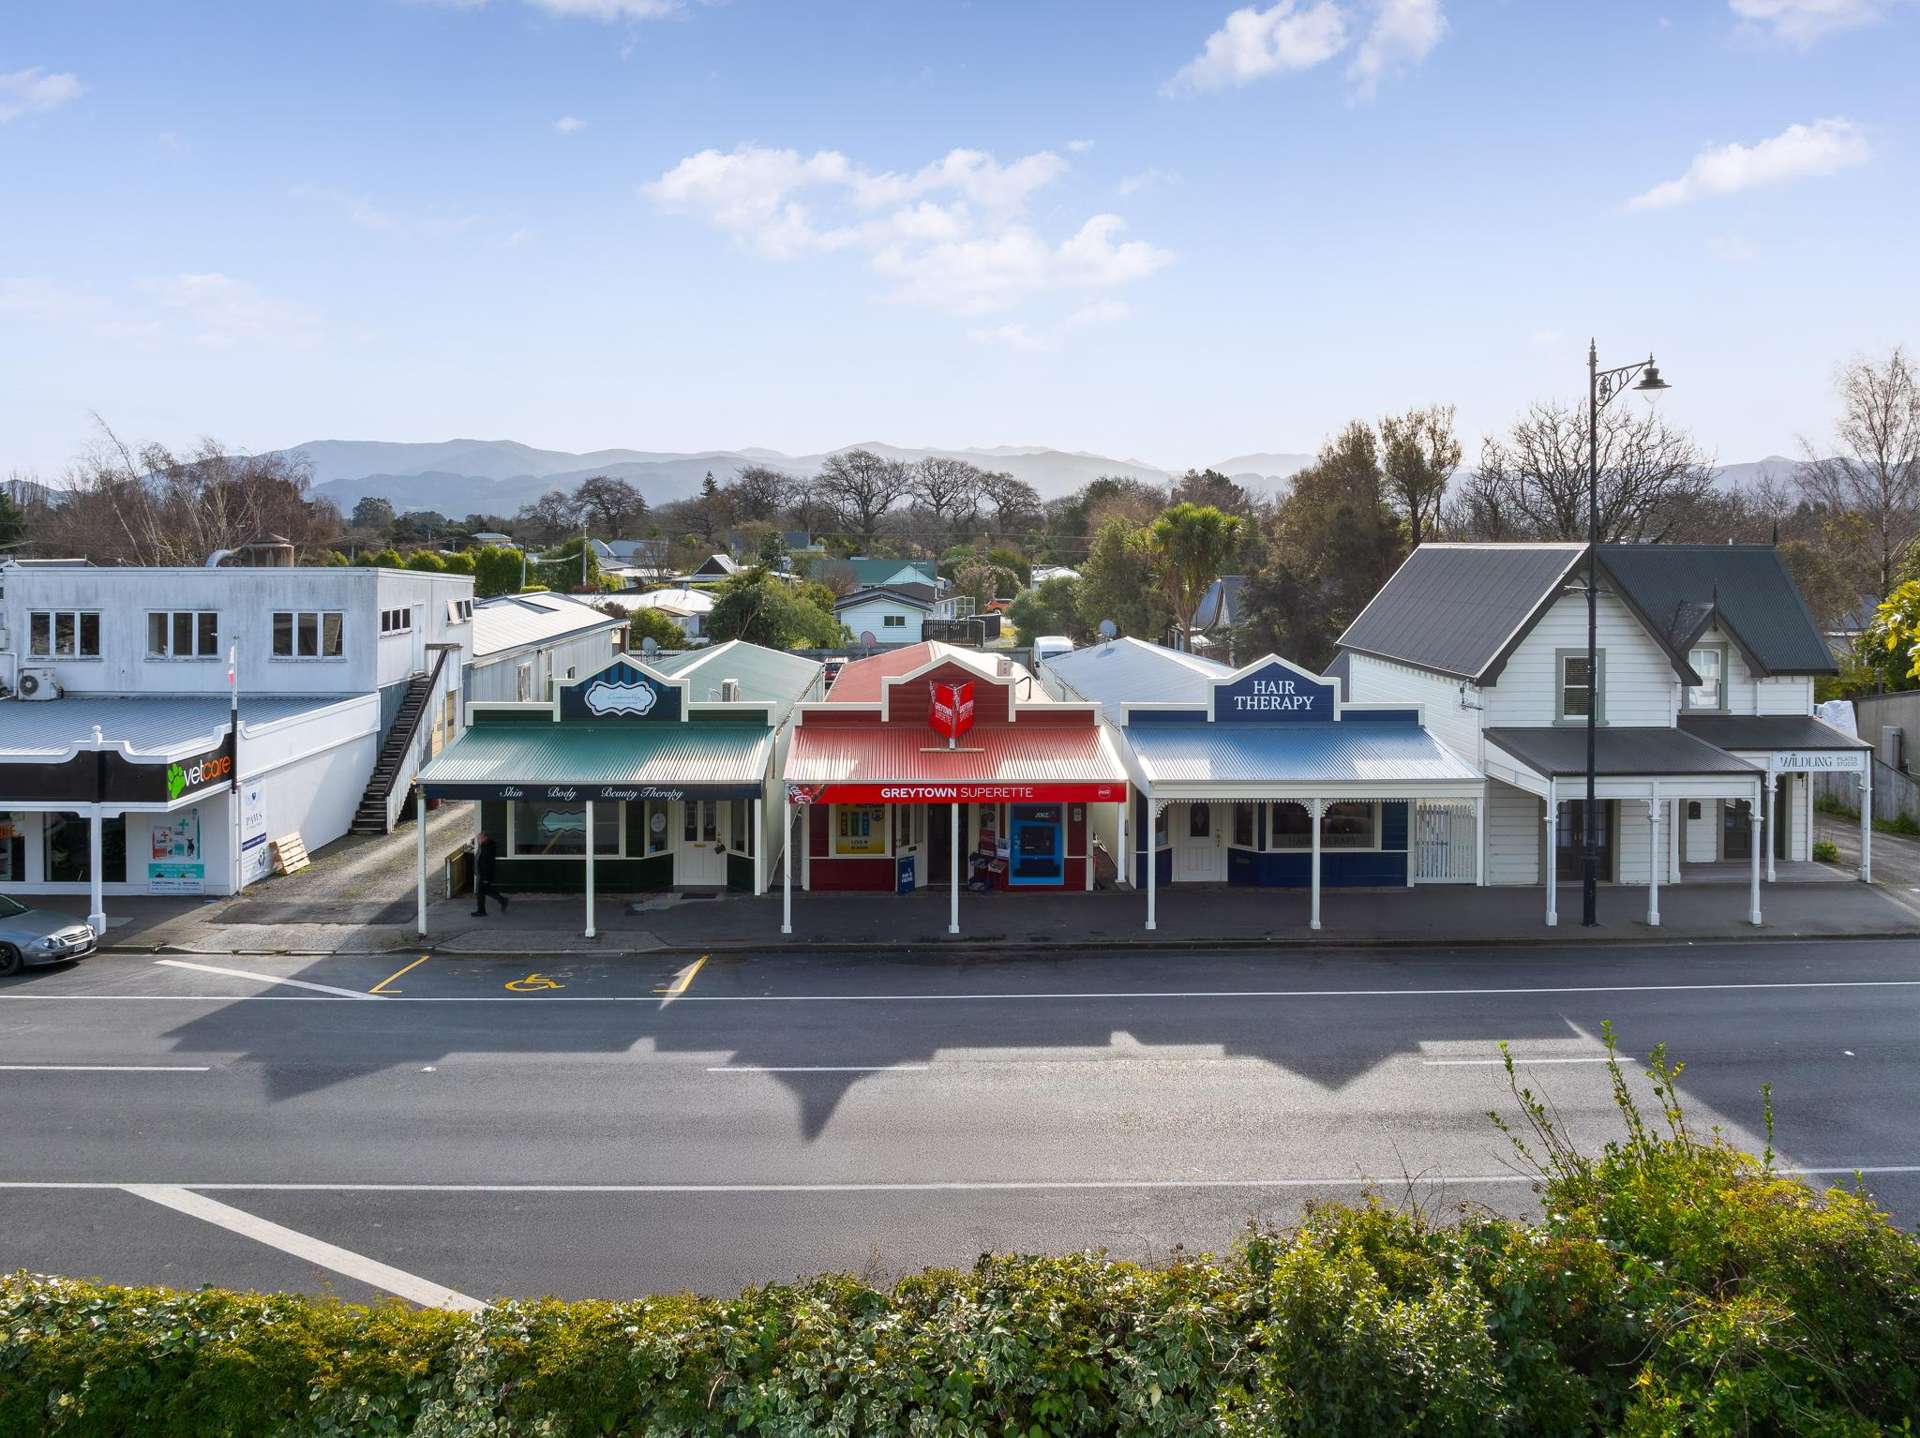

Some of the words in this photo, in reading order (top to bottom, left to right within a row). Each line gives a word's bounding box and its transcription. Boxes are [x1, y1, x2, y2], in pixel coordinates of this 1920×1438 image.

[1253, 680, 1296, 695] HAIR
[1234, 696, 1314, 710] THERAPY
[1780, 753, 1832, 767] WILDLING
[183, 756, 230, 787] vetcare
[499, 786, 524, 798] Skin
[546, 786, 577, 801] Body
[601, 786, 638, 801] Beauty
[640, 786, 684, 801] Therapy
[881, 787, 957, 798] GREYTOWN
[960, 787, 1033, 798] SUPERETTE
